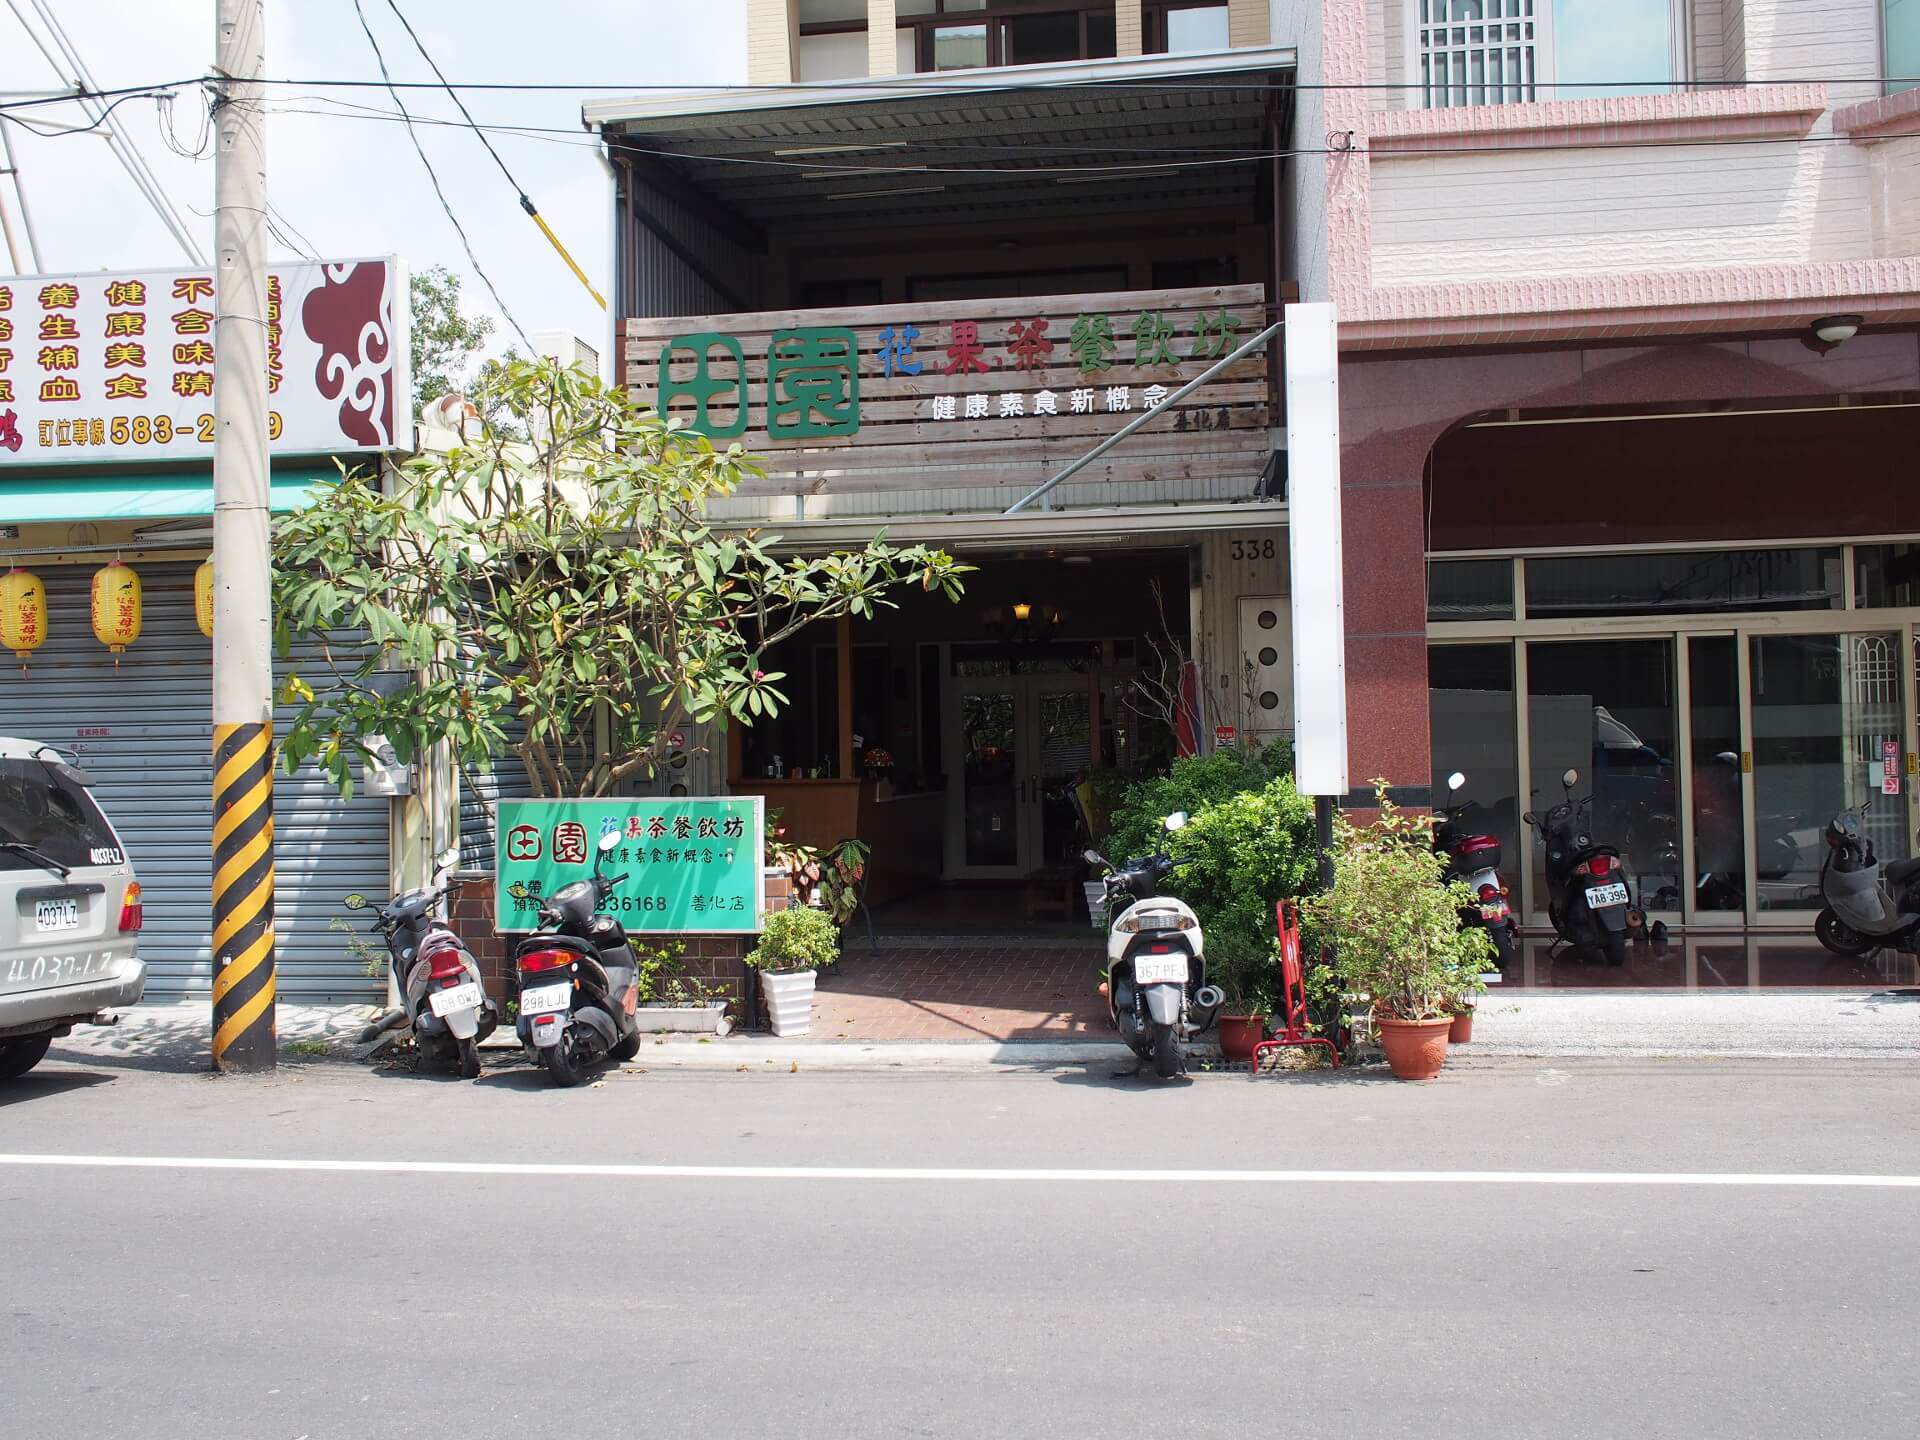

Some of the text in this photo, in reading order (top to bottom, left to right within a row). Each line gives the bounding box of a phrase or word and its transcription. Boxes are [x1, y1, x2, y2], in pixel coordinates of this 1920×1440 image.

[38, 284, 80, 401] 養生補血
[104, 281, 146, 399] 健康美食
[172, 278, 215, 396] 不含味精
[658, 306, 1242, 439] 田園 花果茶餐飲坊
[932, 384, 1168, 420] 健康素食新概念
[38, 418, 105, 447] 訂位專線
[110, 411, 283, 445] 583-29
[1231, 539, 1276, 560] 338
[90, 848, 123, 864] 4037-LZ
[507, 816, 746, 864] 田園 花果茶餐飲坊
[38, 905, 78, 926] 4037-LZ
[523, 992, 568, 1011] 298-LJL
